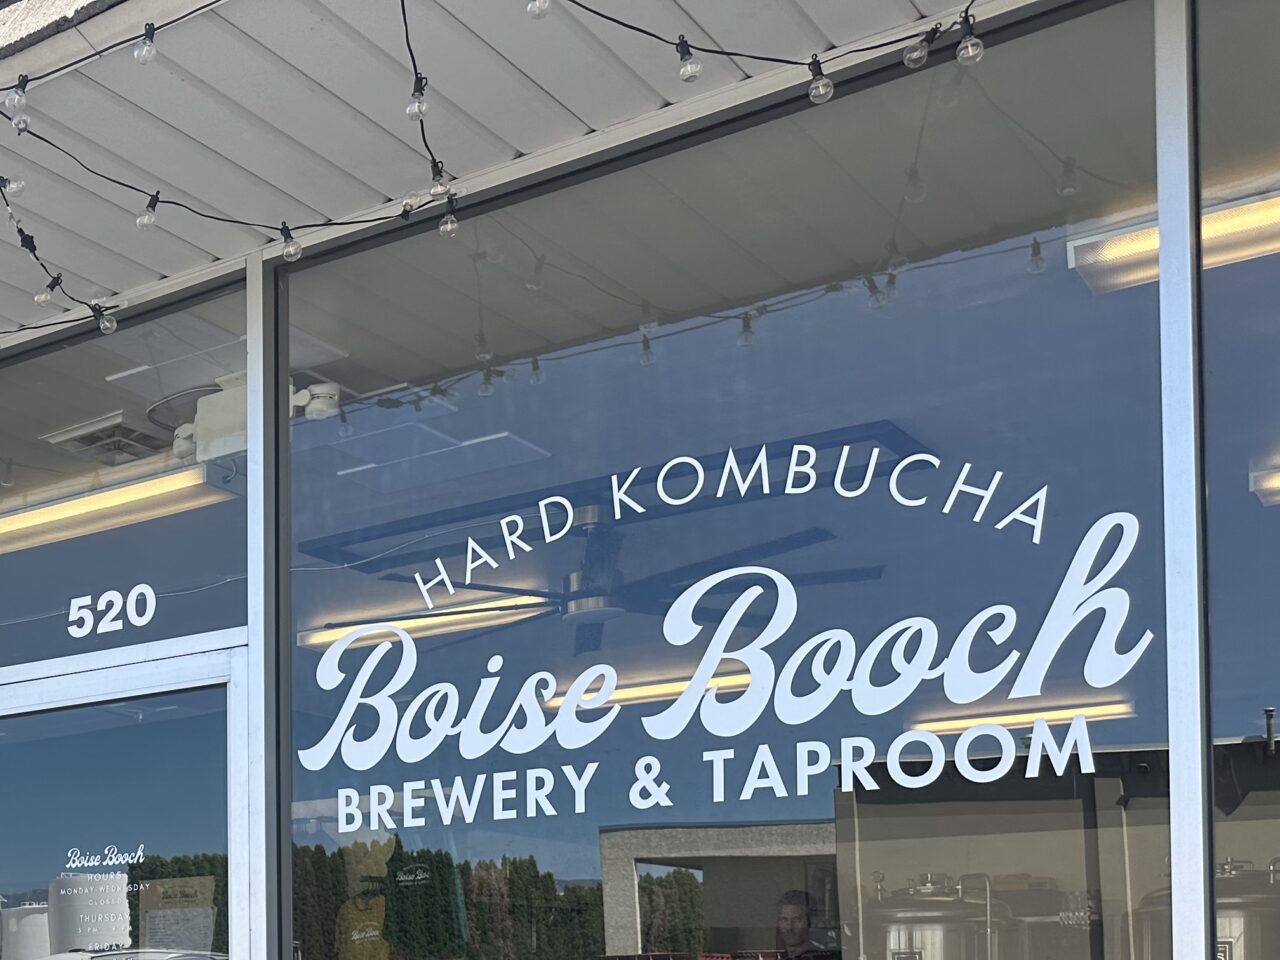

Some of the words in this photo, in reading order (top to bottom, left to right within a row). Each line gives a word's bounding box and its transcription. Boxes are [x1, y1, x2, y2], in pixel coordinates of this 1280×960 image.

[414, 496, 575, 610] HARD
[611, 444, 1048, 545] KOMBUCHA
[67, 583, 157, 638] 520
[297, 619, 622, 771] Boise
[641, 512, 1155, 740] Booch
[337, 762, 600, 833] BREWERY
[629, 755, 674, 810] &
[702, 713, 1097, 803] TAPROOM
[65, 847, 101, 868] Boise
[102, 843, 145, 866] Booch
[87, 871, 122, 882] HOURS
[79, 913, 131, 923] THURSDAY
[88, 942, 125, 951] FRIDAY
